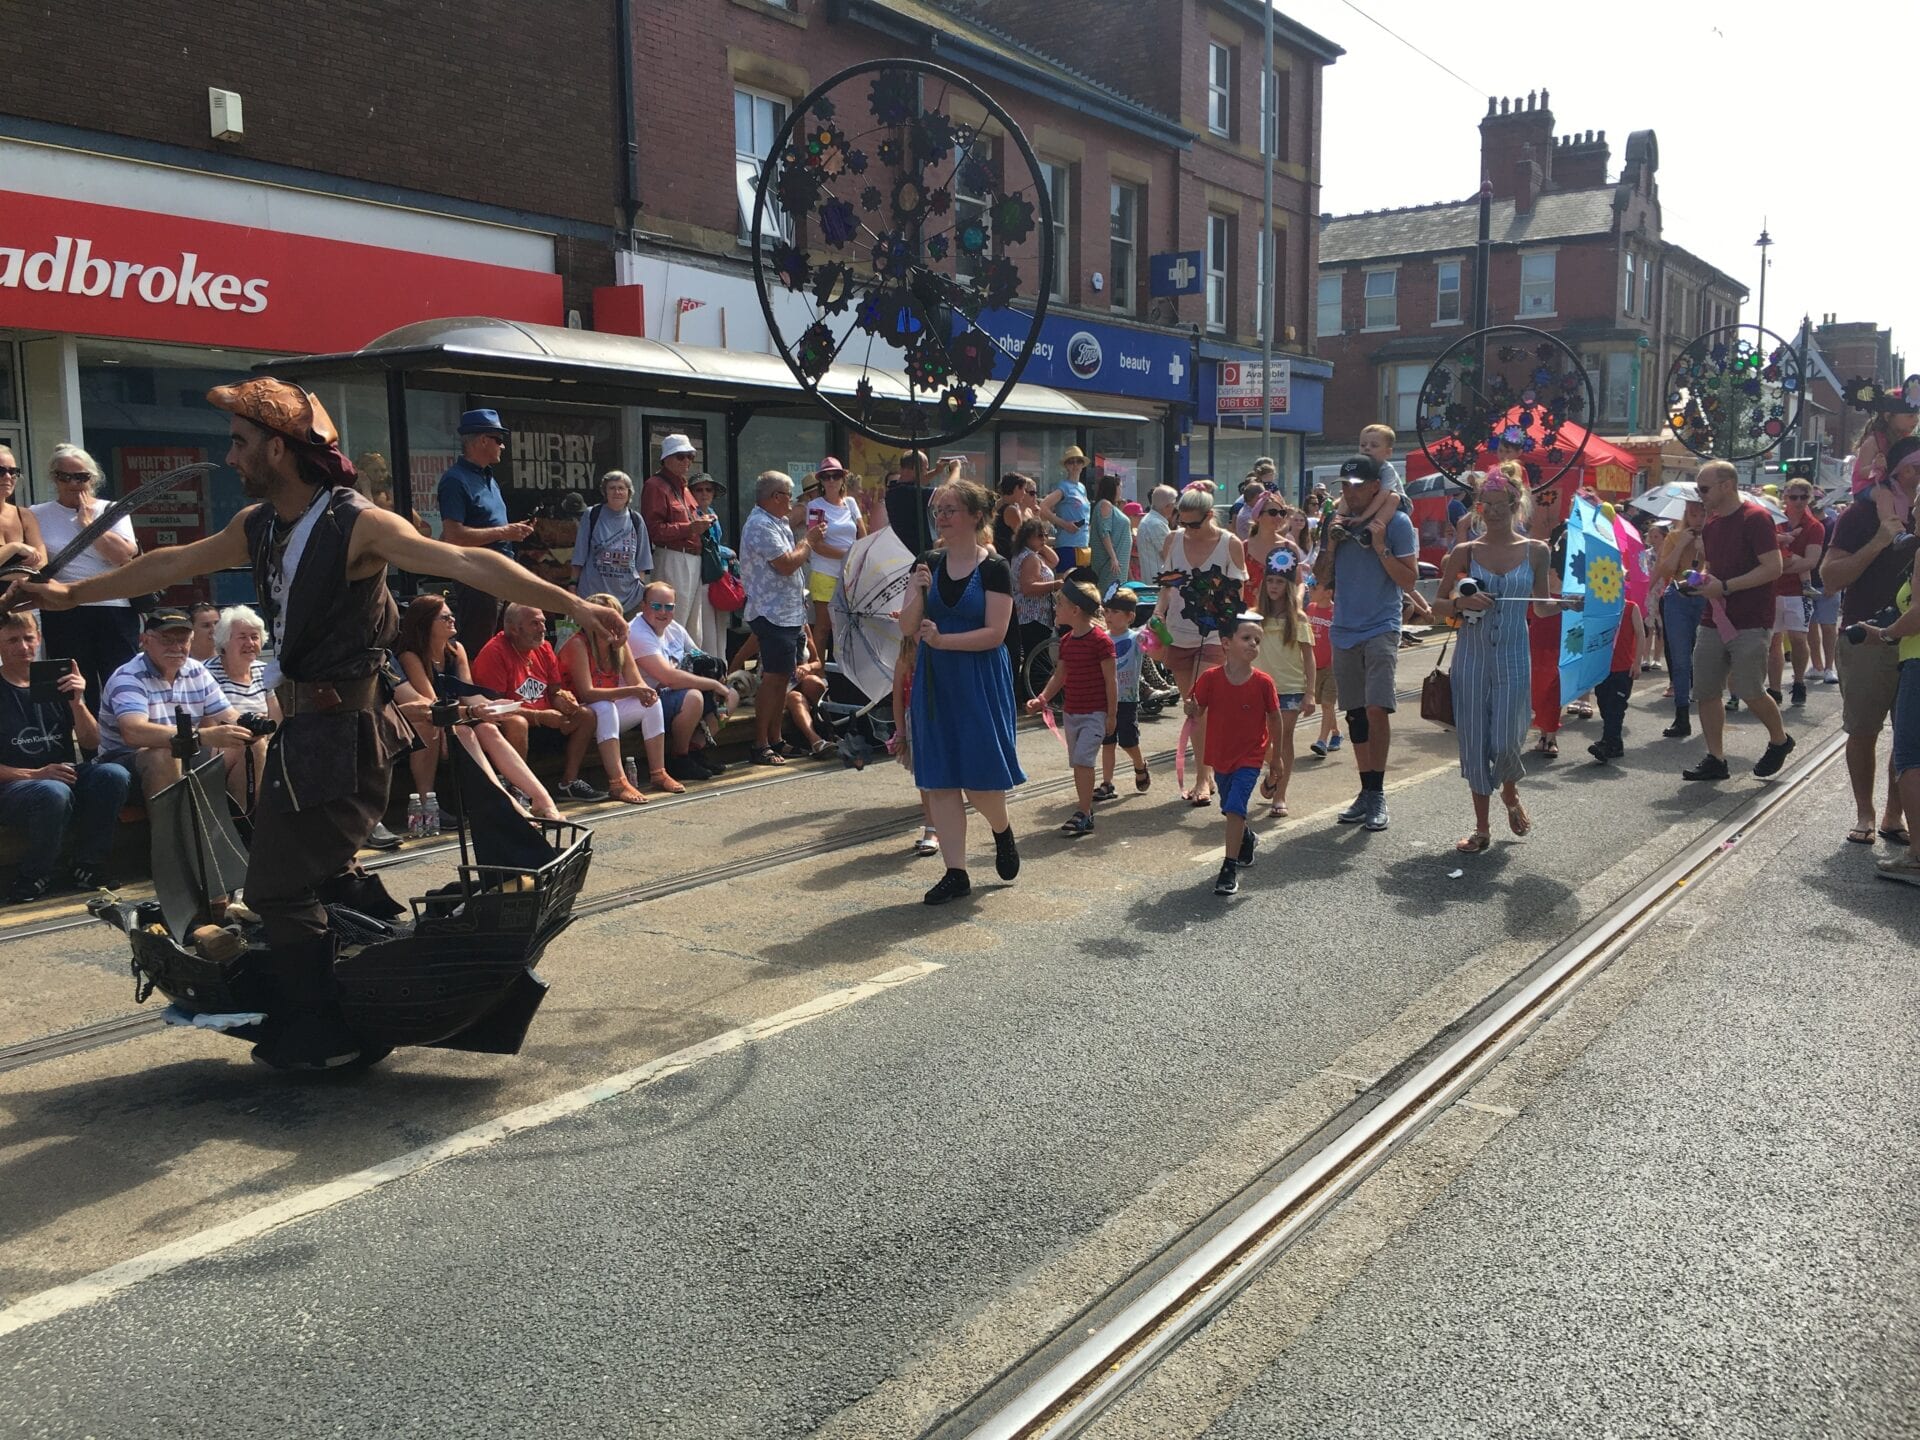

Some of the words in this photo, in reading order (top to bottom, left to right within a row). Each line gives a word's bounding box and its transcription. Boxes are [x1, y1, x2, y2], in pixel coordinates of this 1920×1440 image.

[1000, 333, 1054, 361] pharacy
[1120, 352, 1152, 375] beauty
[1220, 398, 1240, 407] 0161
[1243, 398, 1259, 407] 631
[511, 431, 595, 462] HURRY
[126, 455, 171, 470] WHAT'S
[512, 461, 597, 490] HURRY
